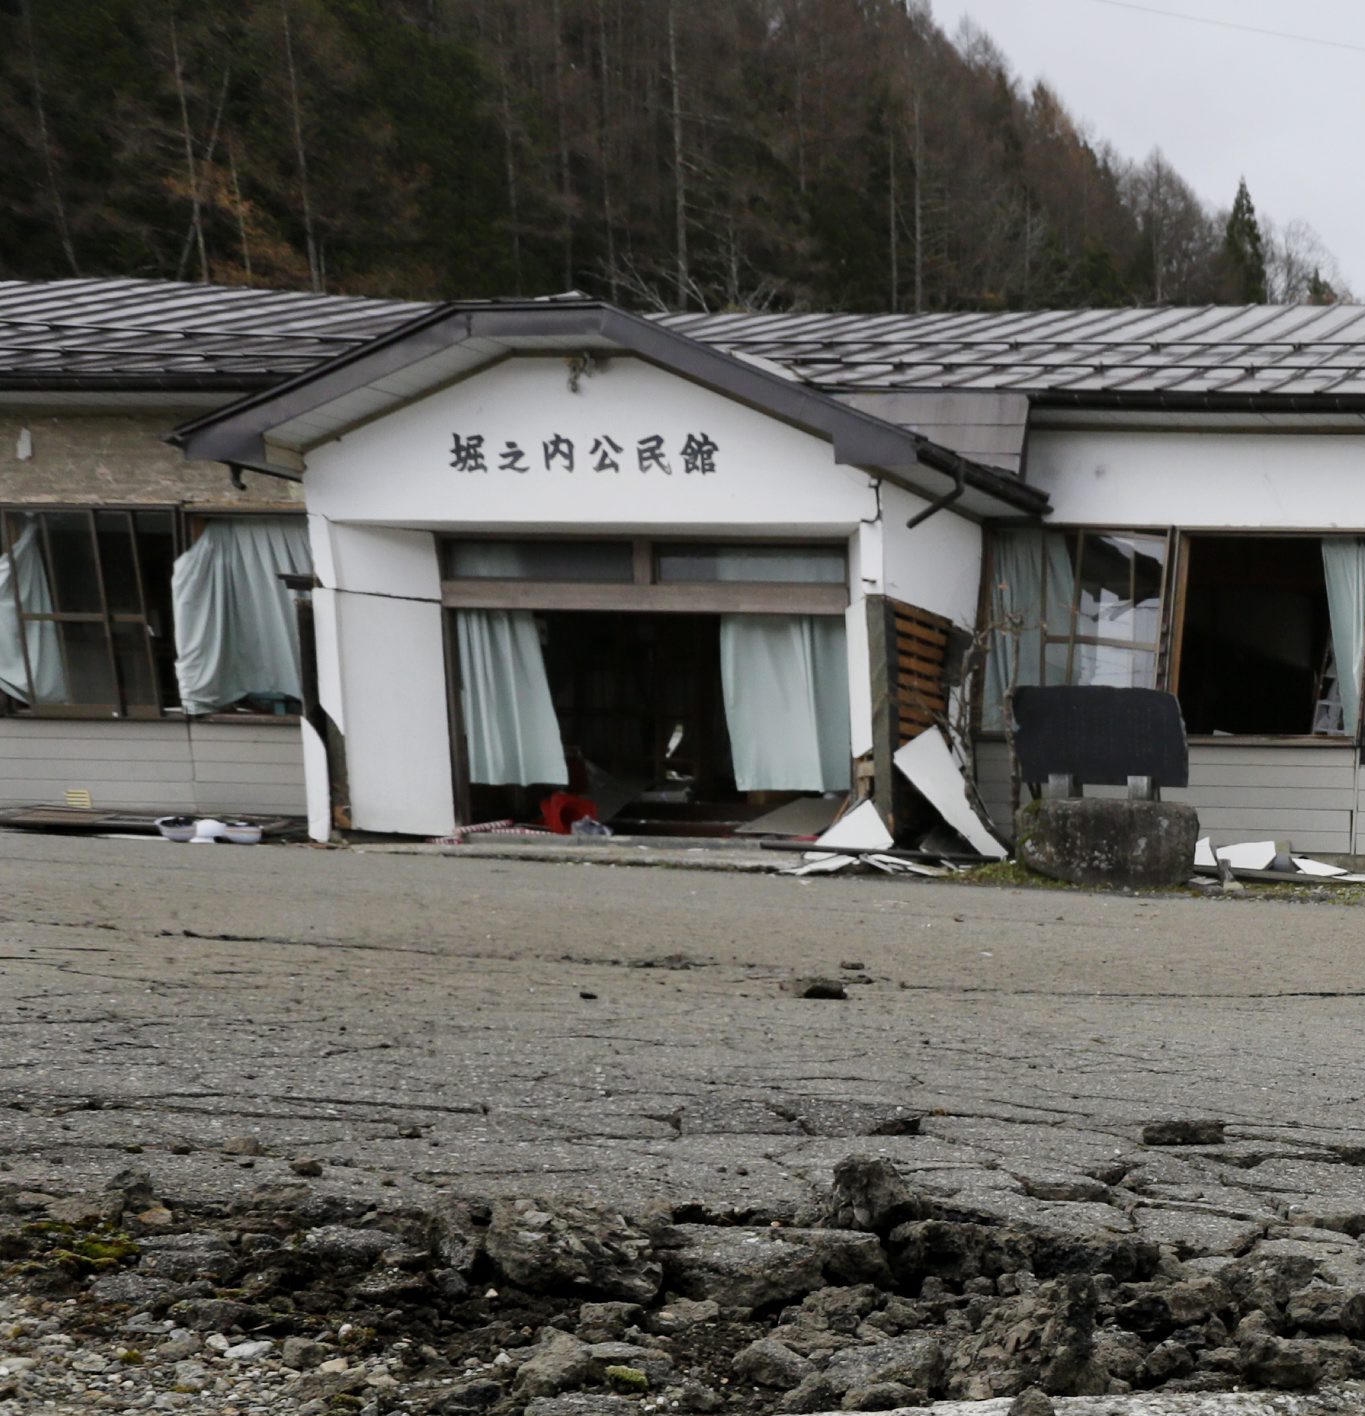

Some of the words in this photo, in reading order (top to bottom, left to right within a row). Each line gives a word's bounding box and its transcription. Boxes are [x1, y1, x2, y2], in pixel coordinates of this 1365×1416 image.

[450, 432, 719, 476] 堀之内公民館
